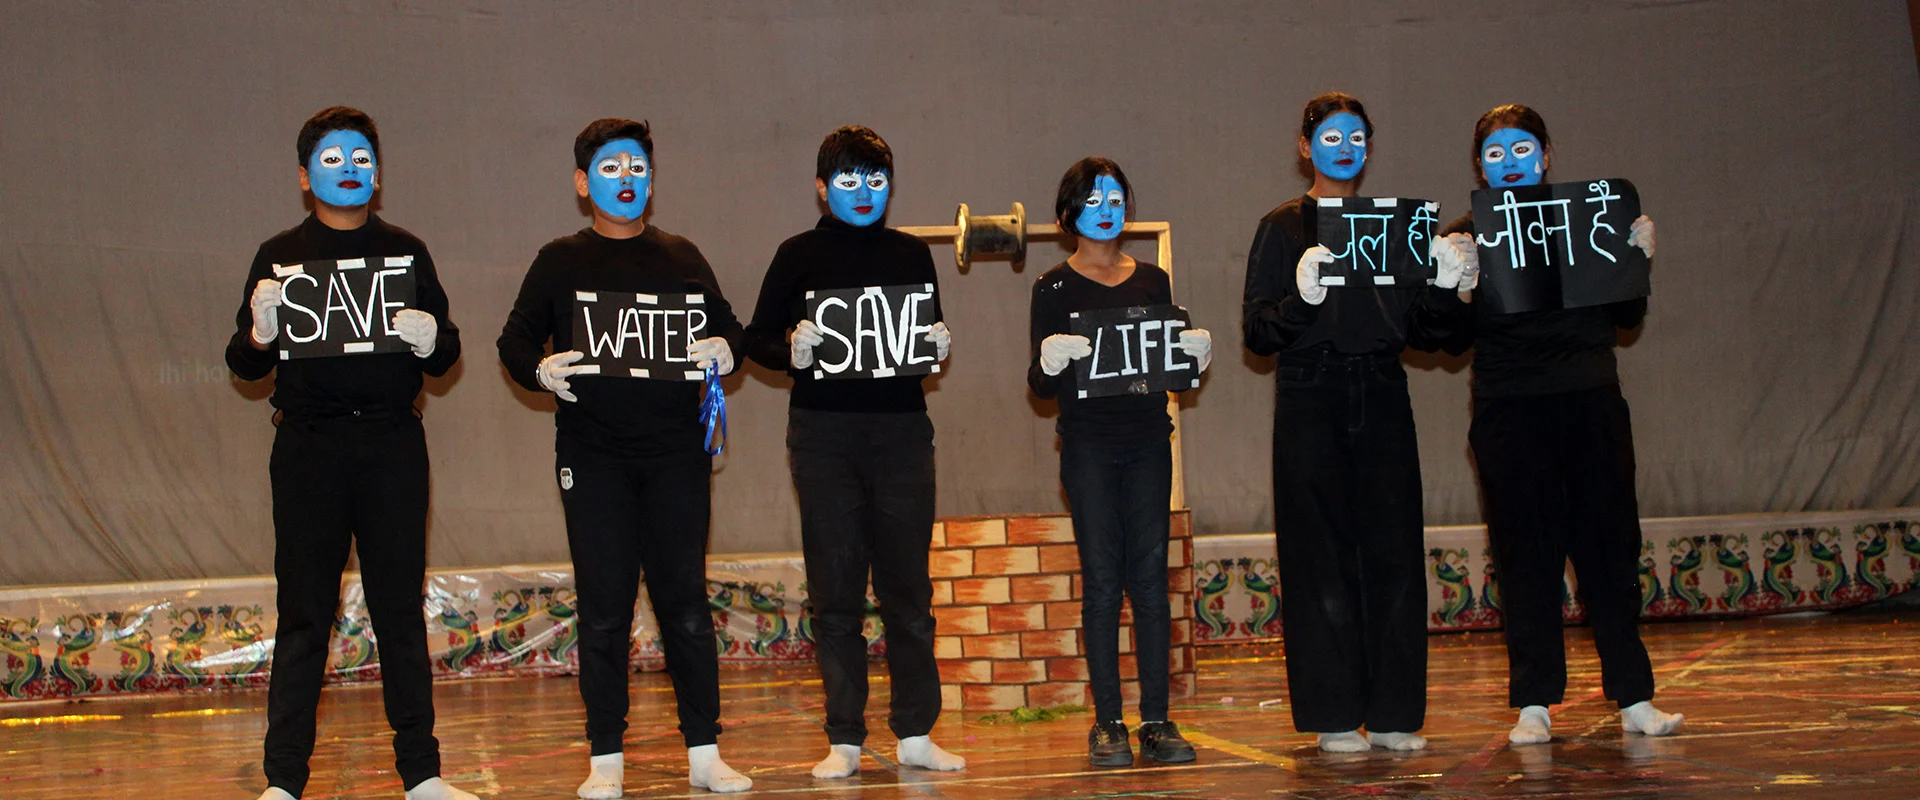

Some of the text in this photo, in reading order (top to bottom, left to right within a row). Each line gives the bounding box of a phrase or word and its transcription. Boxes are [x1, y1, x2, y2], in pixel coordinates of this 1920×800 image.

[1318, 206, 1438, 272] जल ही
[1476, 179, 1621, 269] जीवन है
[281, 268, 407, 343] SAVE
[583, 306, 707, 362] WATER
[815, 292, 935, 374] SAVE
[1089, 319, 1191, 379] LIFE
